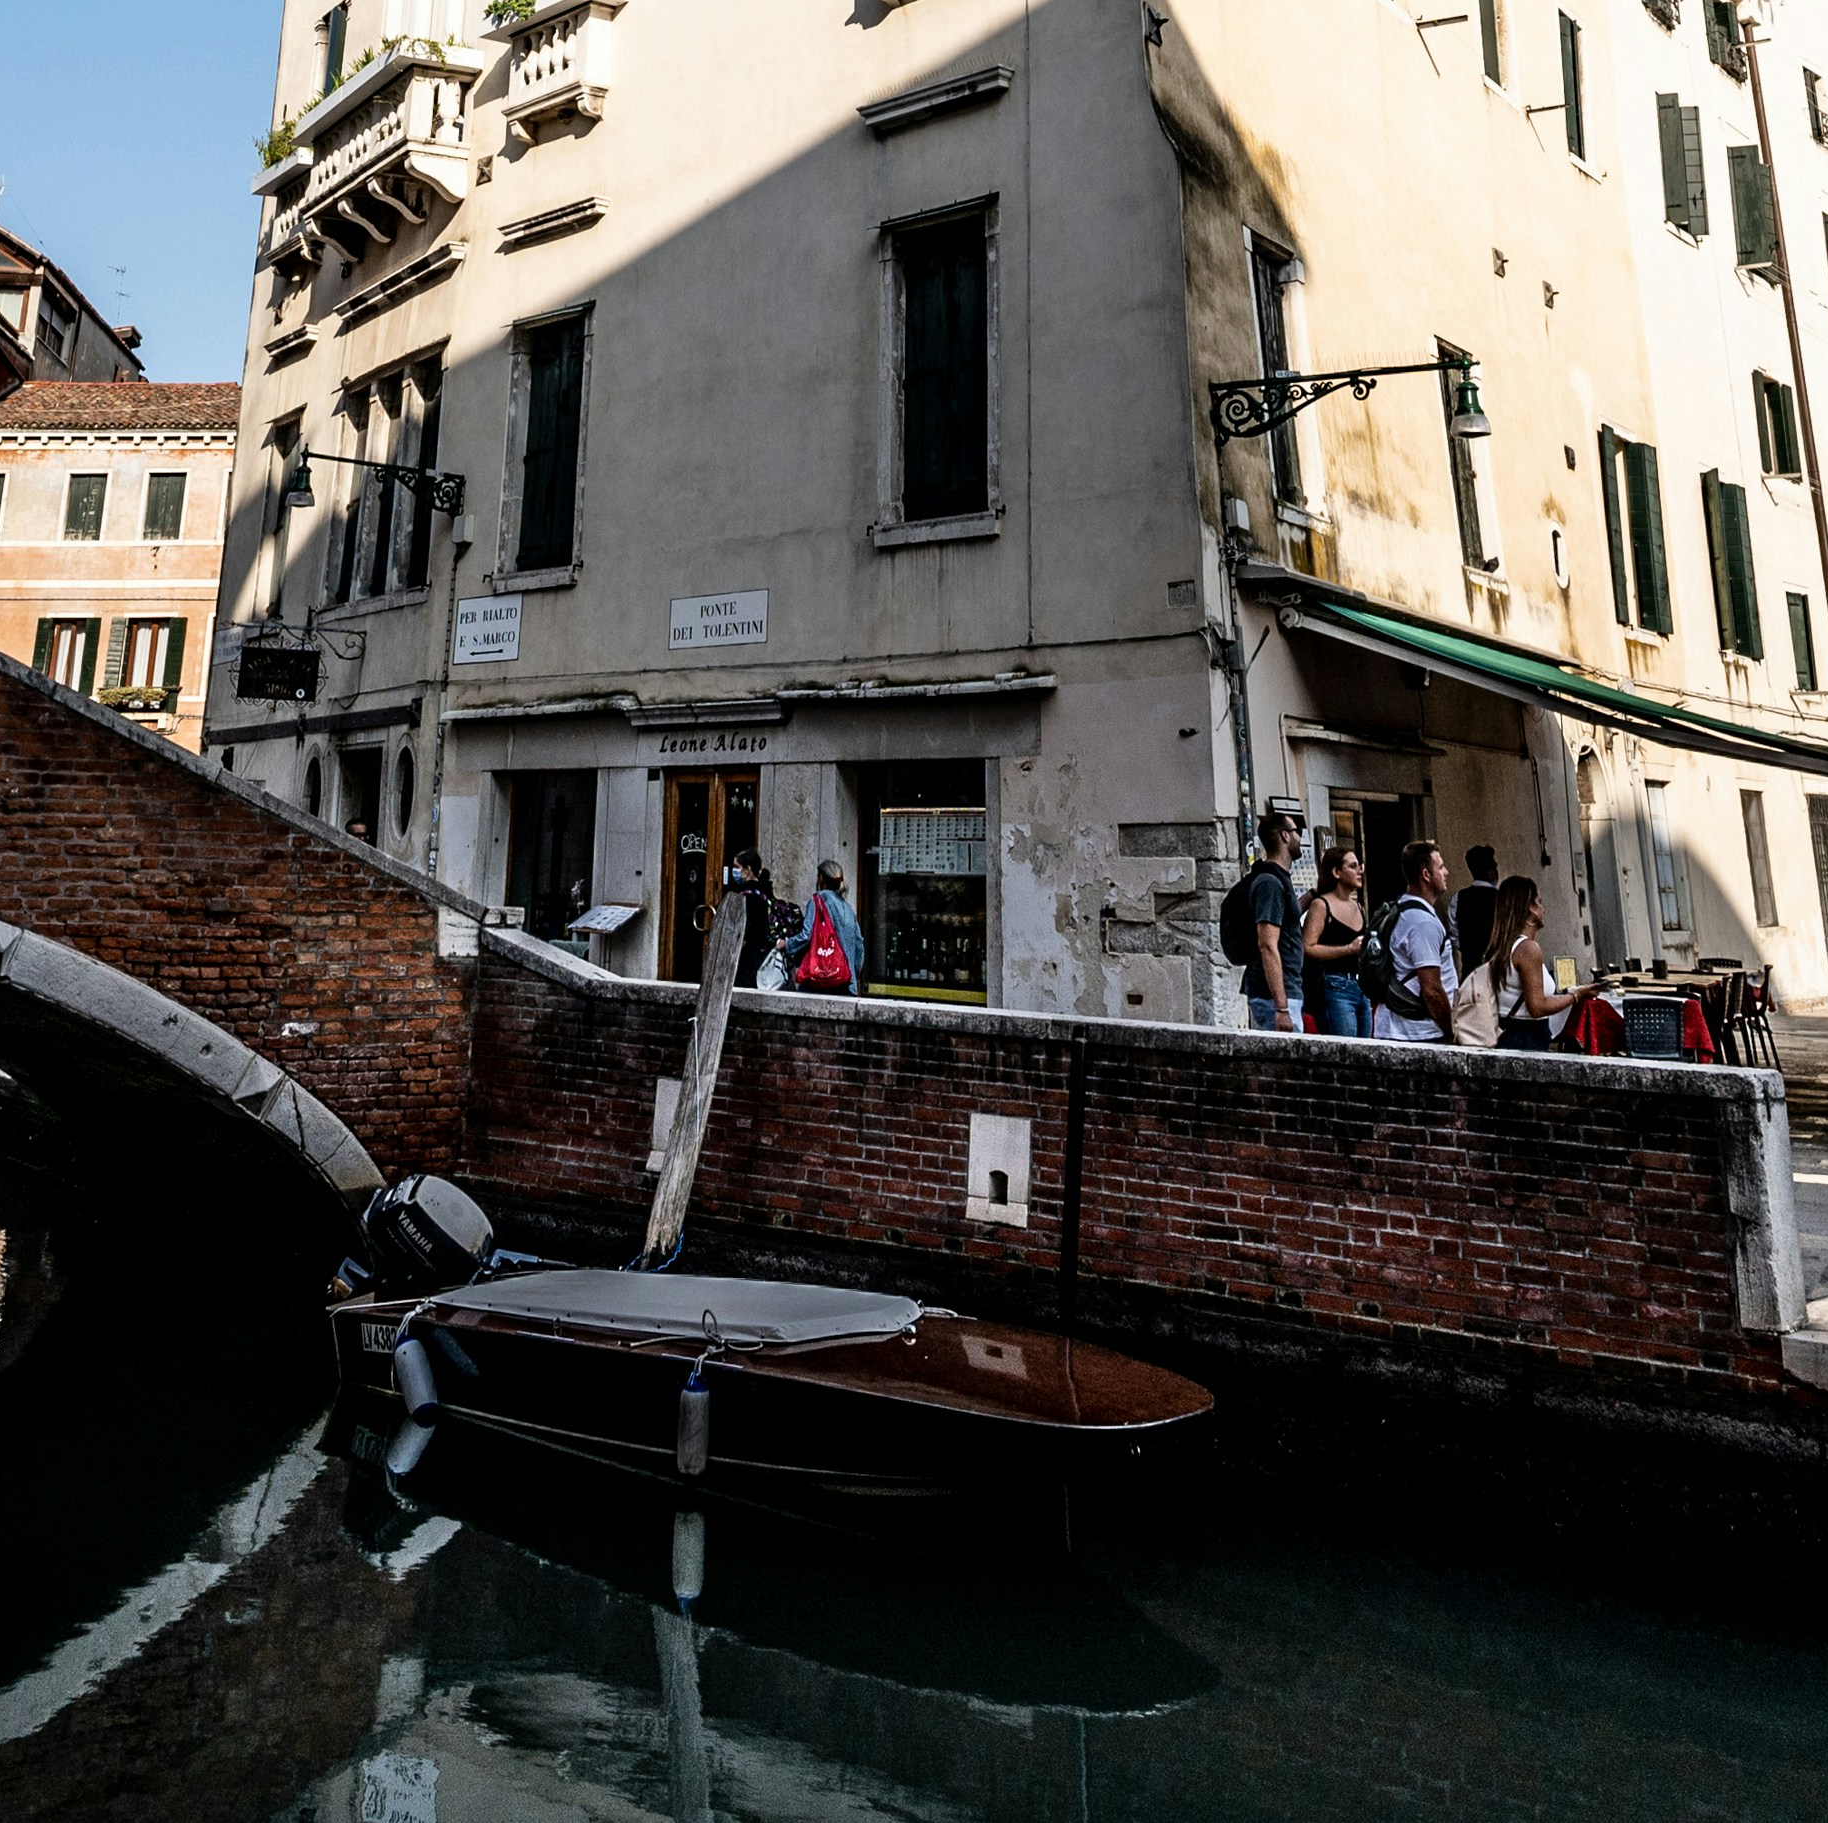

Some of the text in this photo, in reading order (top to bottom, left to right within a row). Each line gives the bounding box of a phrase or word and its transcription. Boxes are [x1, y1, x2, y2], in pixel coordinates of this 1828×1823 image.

[459, 607, 518, 624] PER RIALTO
[700, 601, 737, 618] PONTE
[459, 630, 516, 648] E S.MARCO
[673, 620, 764, 641] DEI TOLENTINI
[659, 731, 767, 753] Leone Alato
[397, 1210, 433, 1253] YAMAHA
